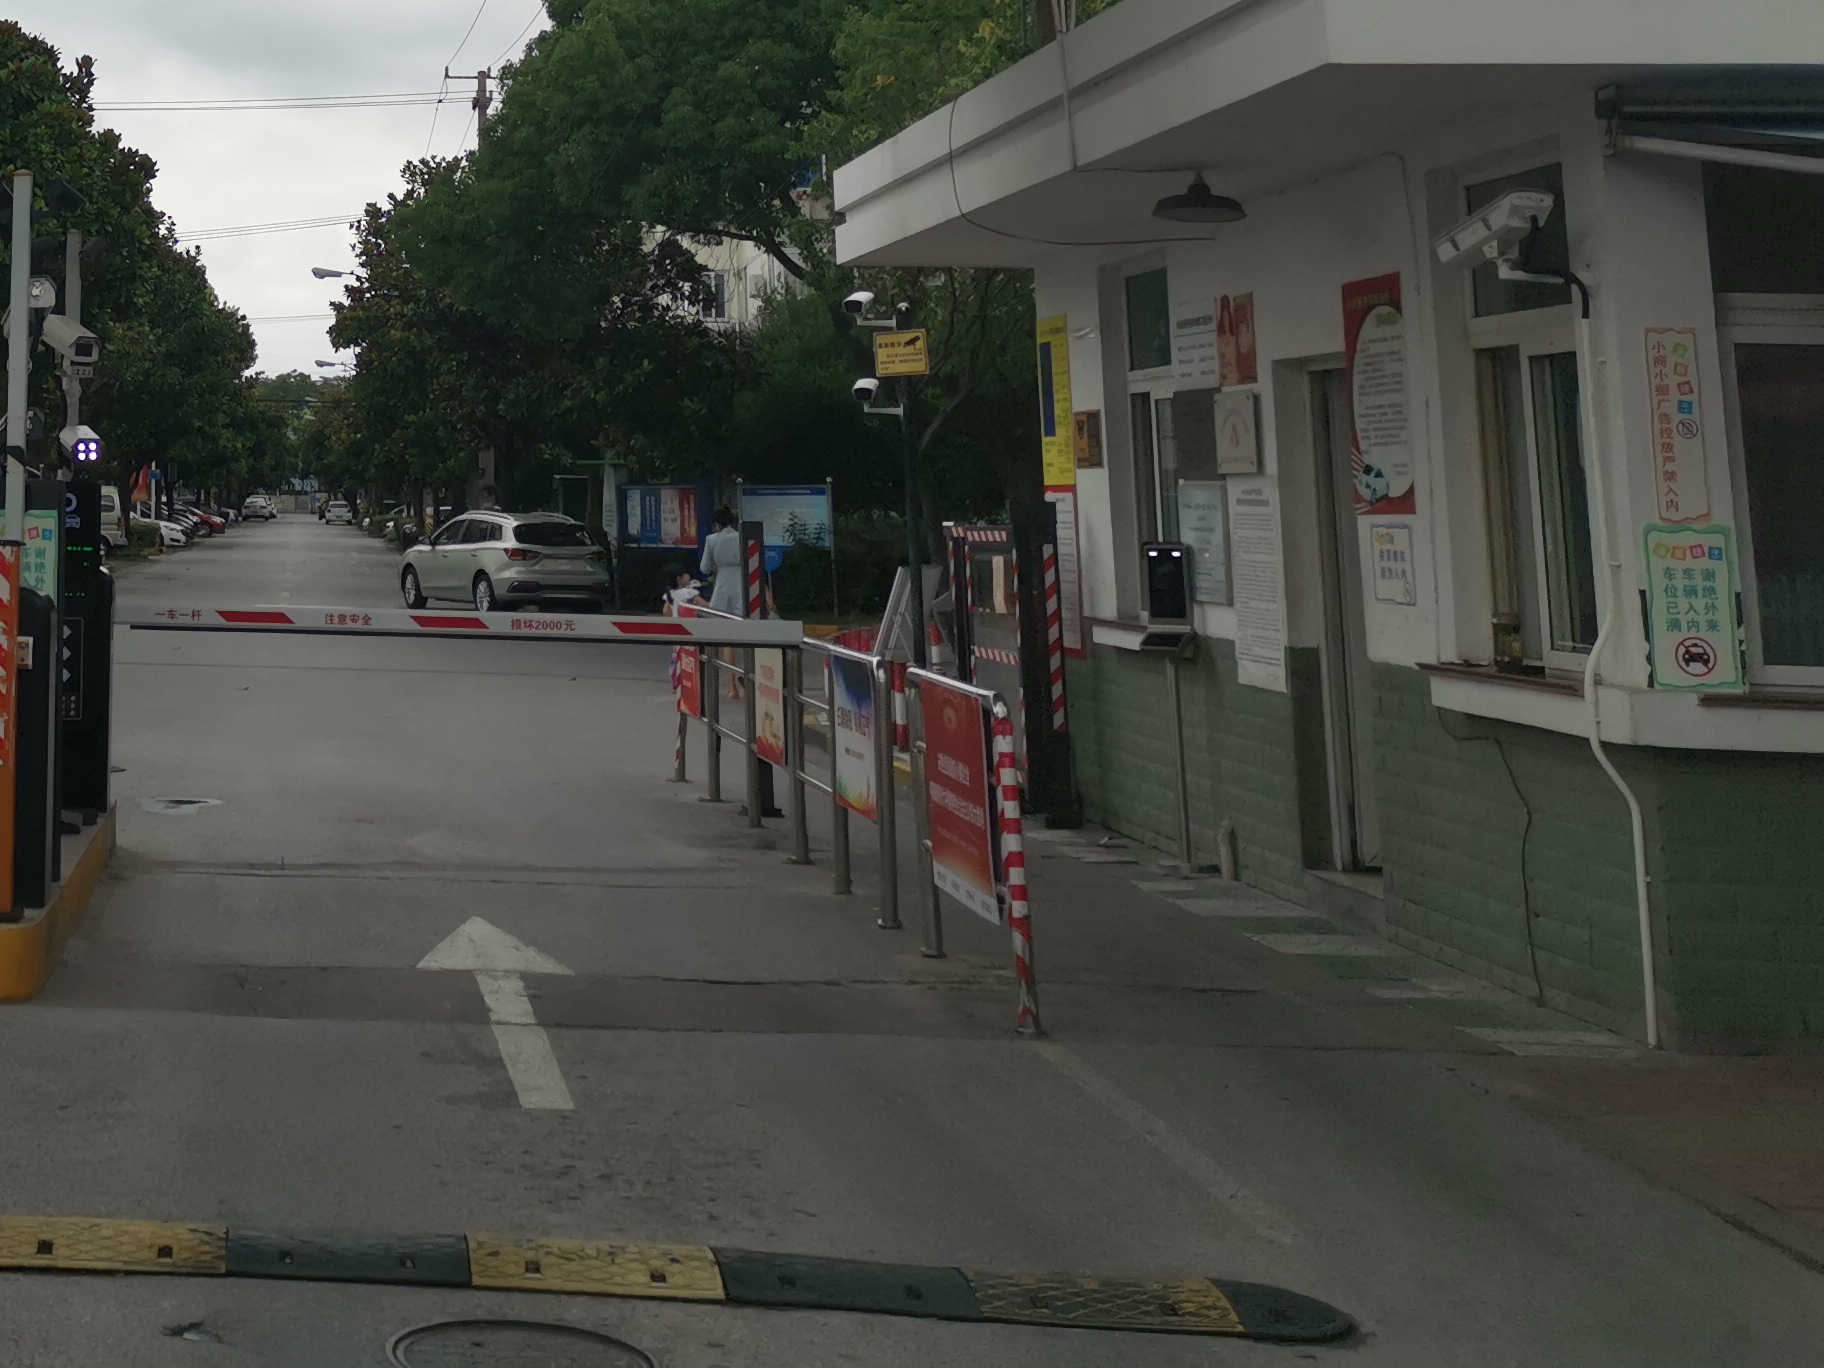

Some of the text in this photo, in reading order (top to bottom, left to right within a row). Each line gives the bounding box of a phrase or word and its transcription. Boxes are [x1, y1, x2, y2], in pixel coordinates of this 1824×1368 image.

[155, 609, 202, 621] 一车一杆
[324, 613, 373, 626] 注意安全
[510, 618, 576, 632] 损坏2000元
